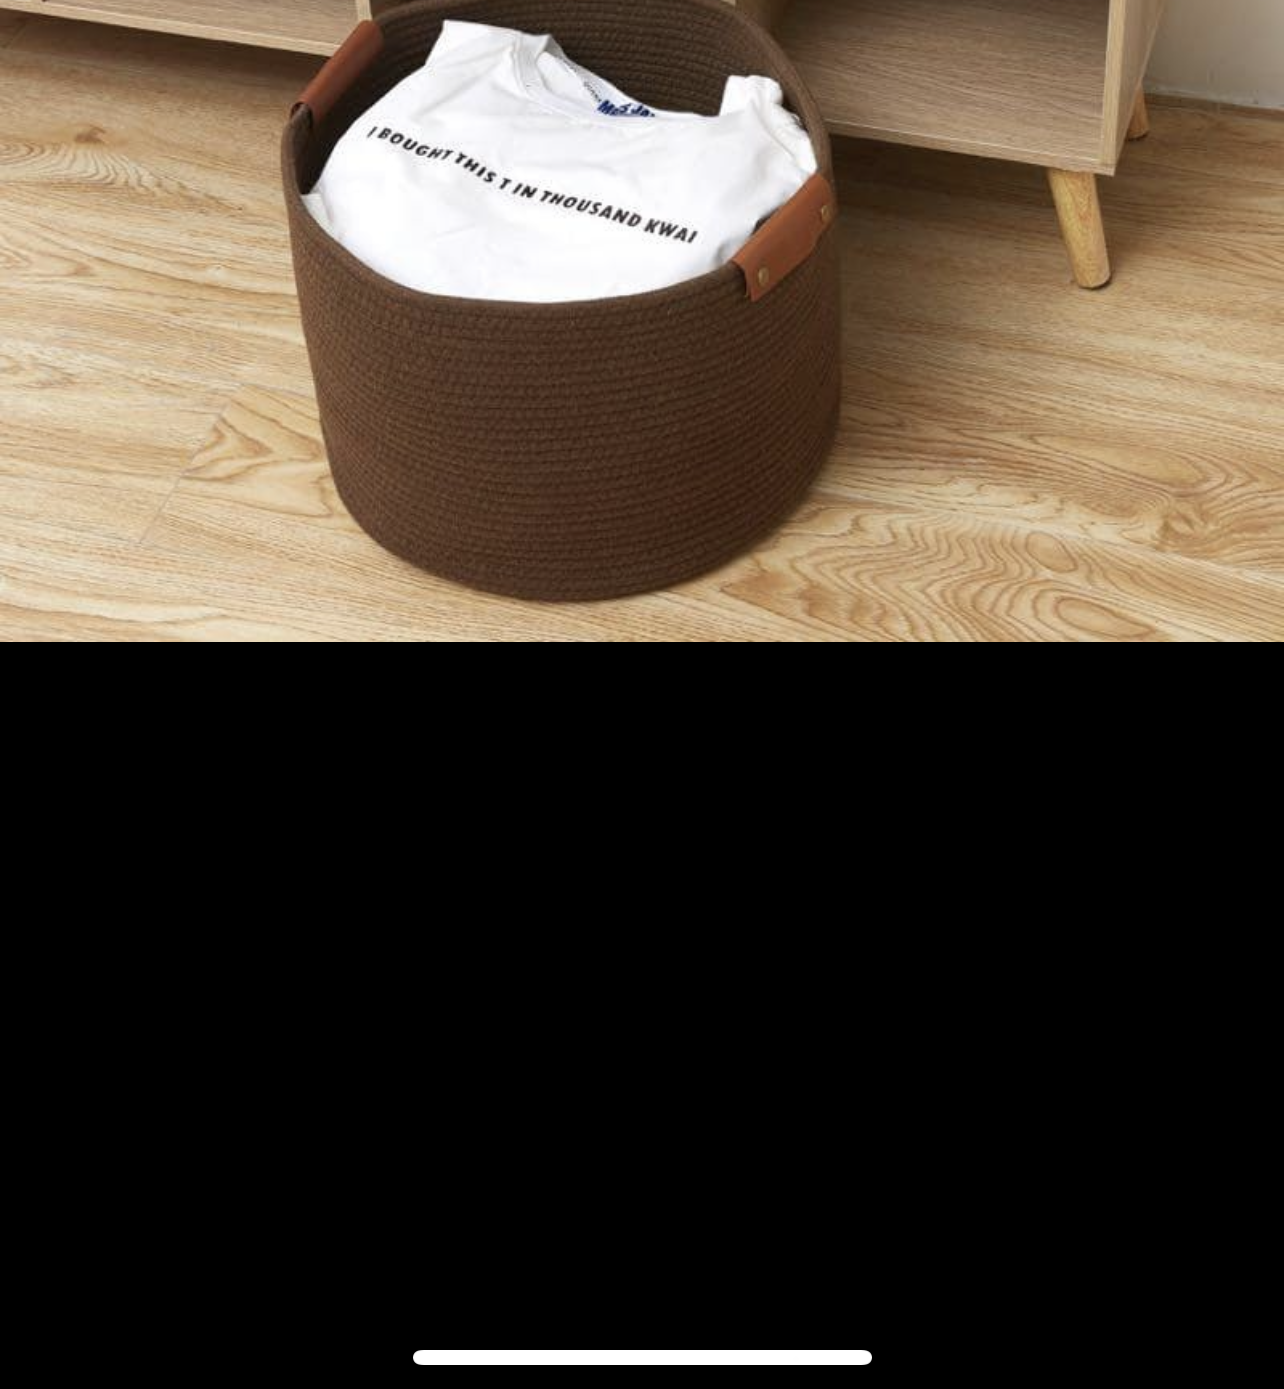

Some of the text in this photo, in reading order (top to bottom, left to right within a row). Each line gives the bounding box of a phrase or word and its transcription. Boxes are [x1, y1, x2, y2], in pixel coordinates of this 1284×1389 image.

[376, 127, 454, 161] BOUGHT
[454, 152, 498, 184] THIS
[499, 177, 512, 190] T
[512, 182, 538, 199] IN
[539, 190, 642, 228] THOUSAND
[643, 217, 698, 244] KWAI
